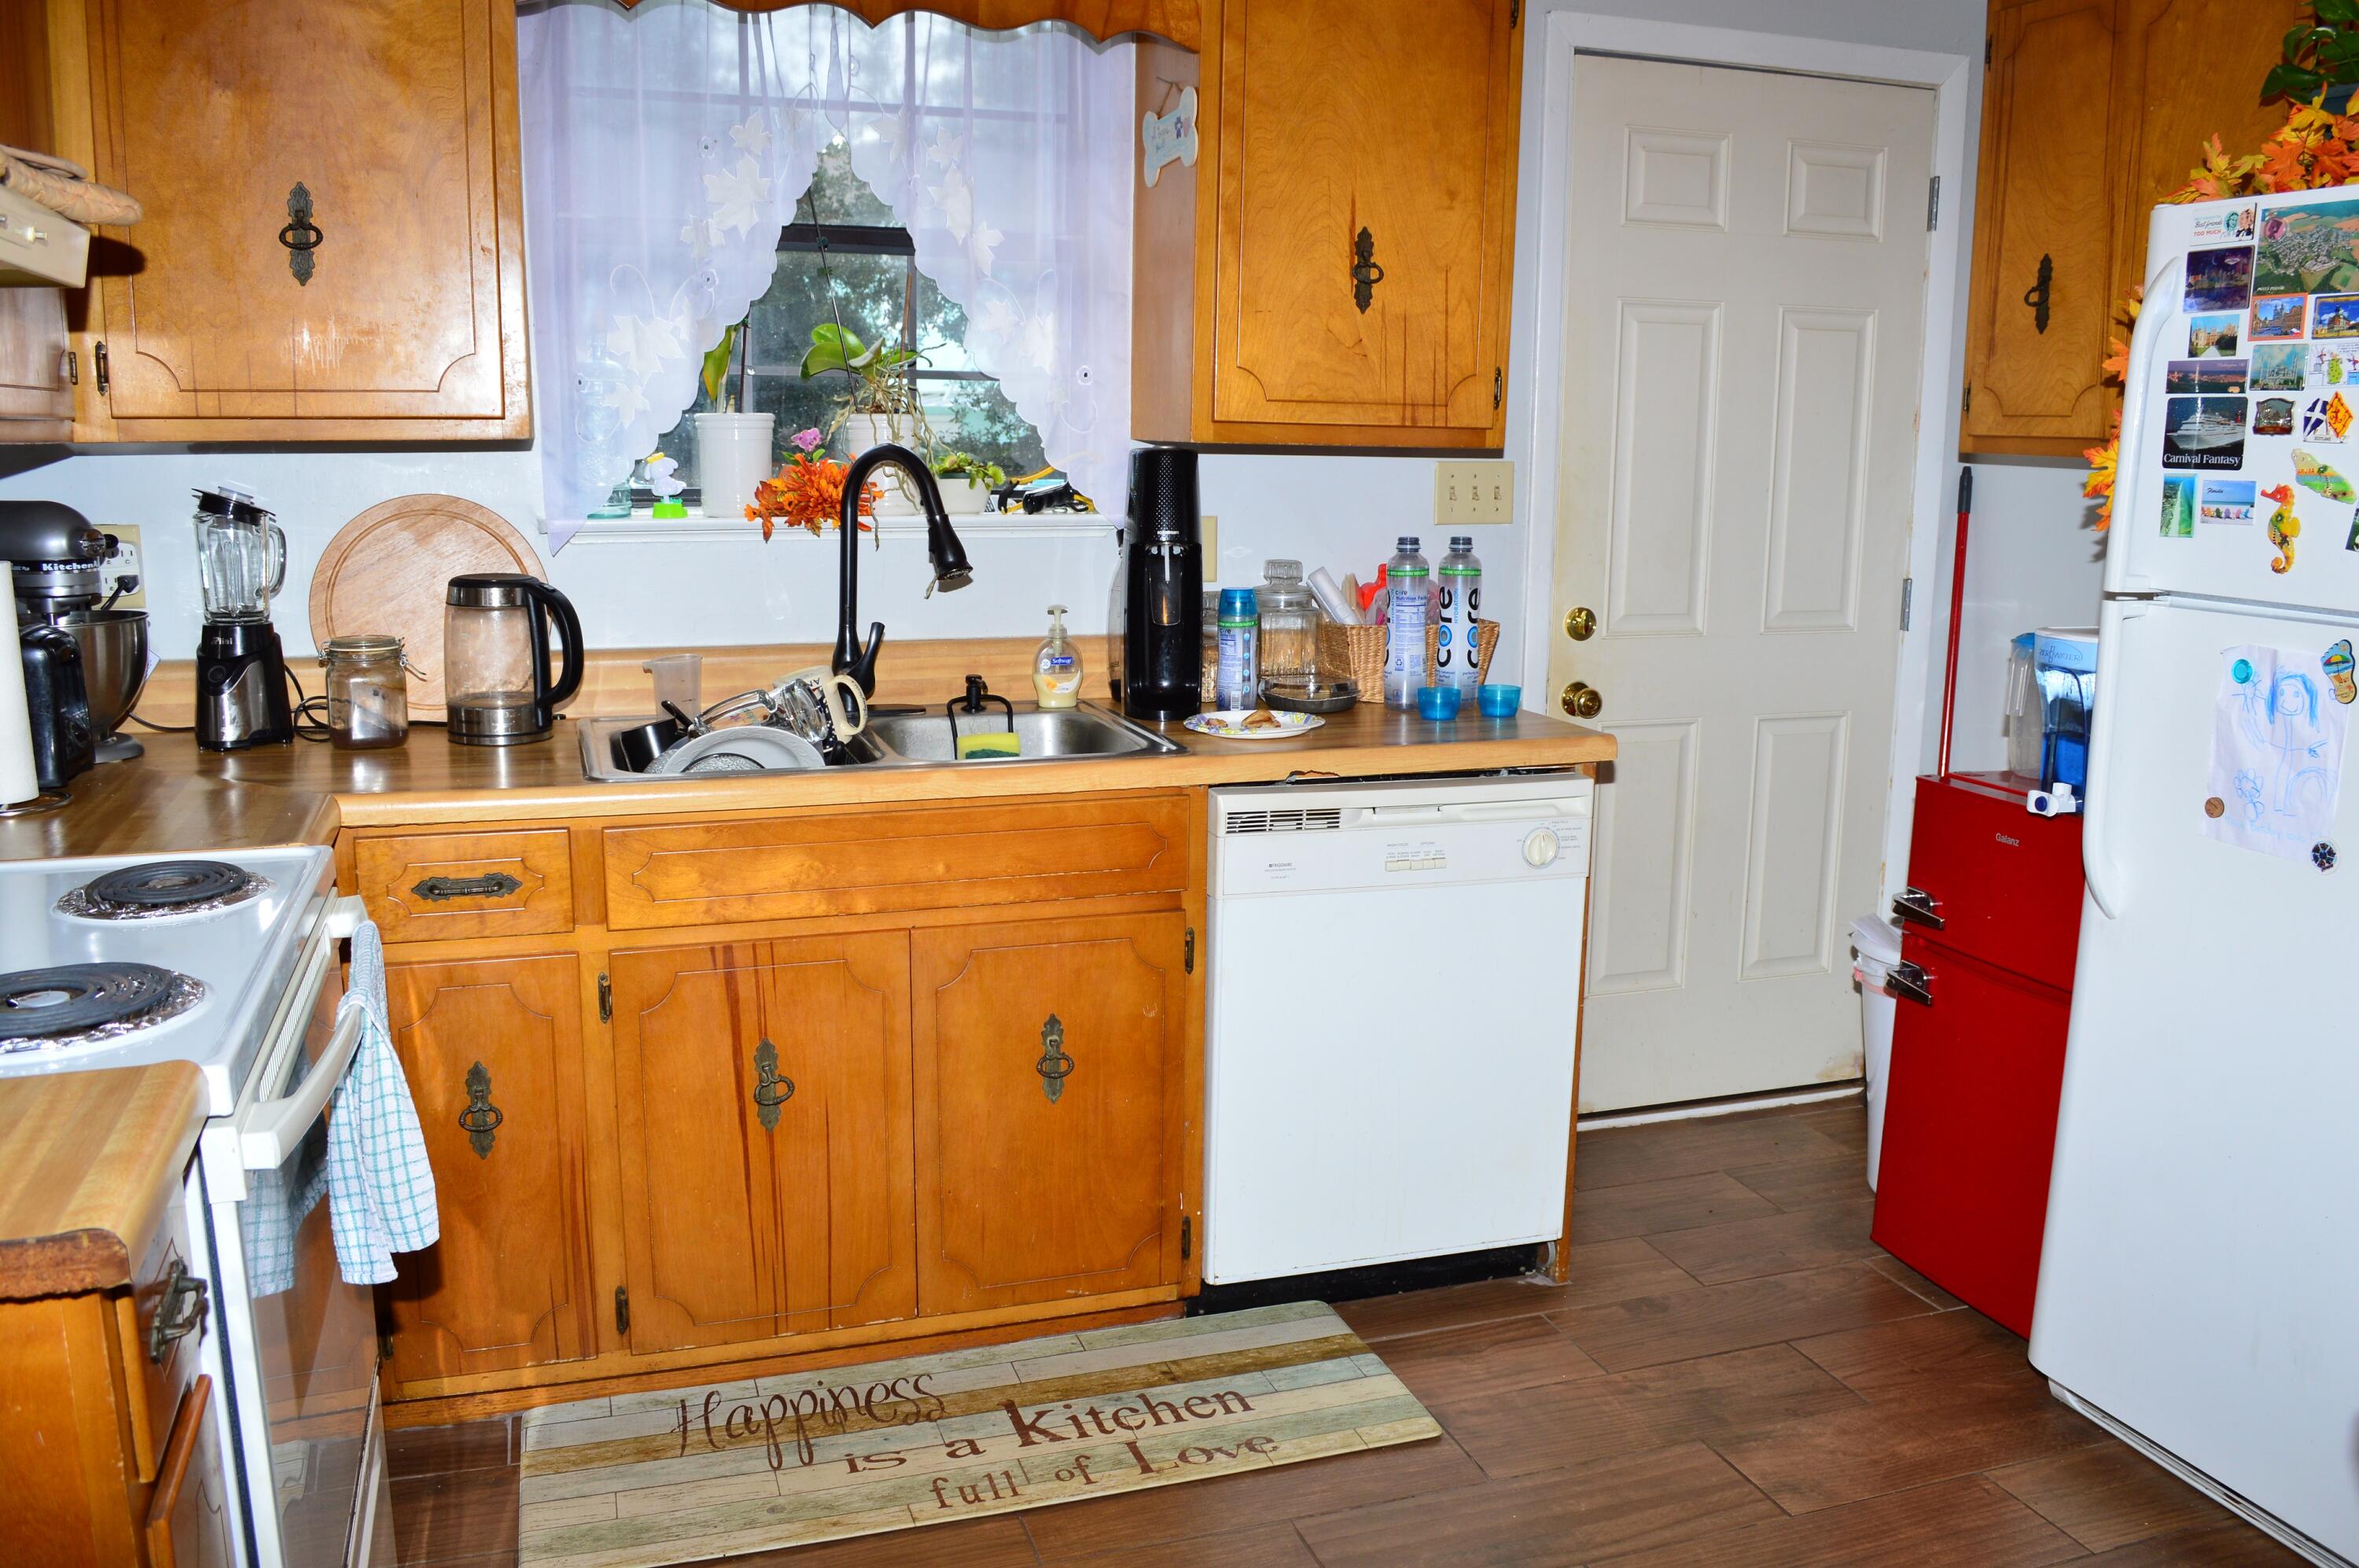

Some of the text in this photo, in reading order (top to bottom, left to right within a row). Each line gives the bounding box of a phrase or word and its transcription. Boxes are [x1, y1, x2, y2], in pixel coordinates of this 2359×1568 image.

[2164, 454, 2240, 466] Carnival Fantasy
[42, 560, 99, 571] KitchenA
[1437, 587, 1452, 668] core
[1996, 832, 2019, 847] Galanz
[663, 1374, 948, 1470] Happiness
[845, 1451, 907, 1474] is
[945, 1438, 987, 1459] a
[929, 1436, 1279, 1509] full of Love
